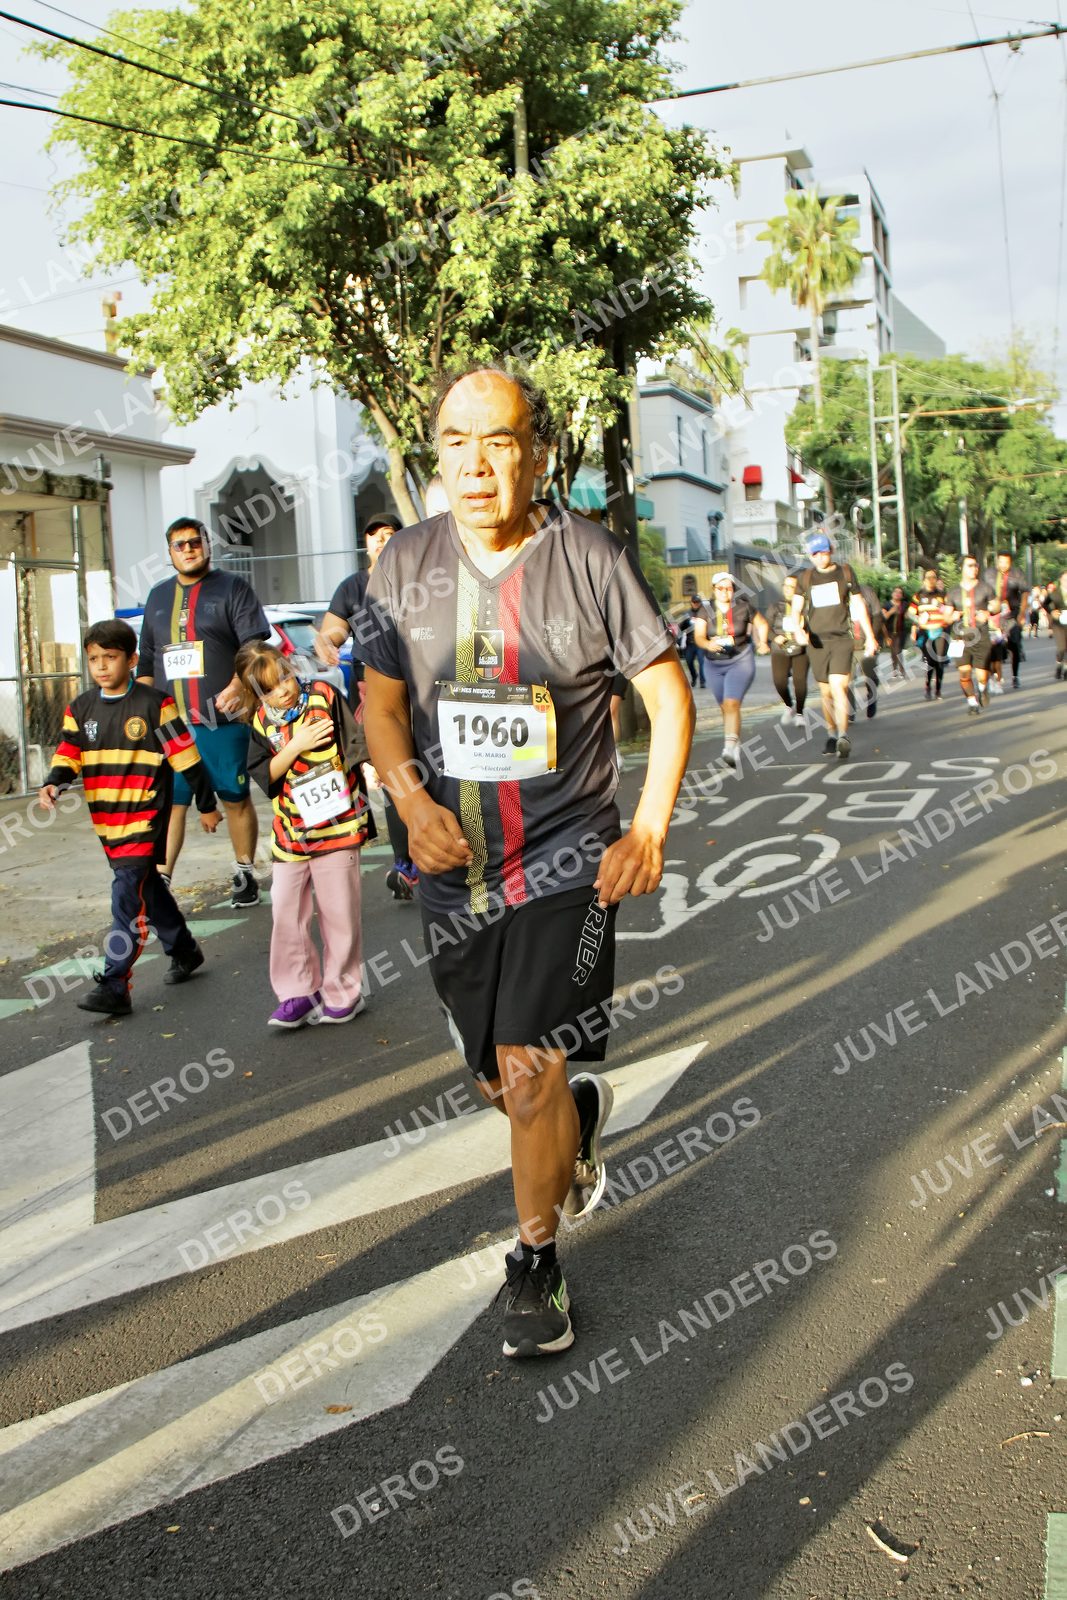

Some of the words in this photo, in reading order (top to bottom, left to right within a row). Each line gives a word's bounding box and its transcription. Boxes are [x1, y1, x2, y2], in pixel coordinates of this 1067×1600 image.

[167, 654, 193, 668] 5487
[535, 691, 549, 704] 5K
[452, 714, 529, 748] 1960
[300, 778, 341, 807] 1554
[572, 894, 608, 986] RTER
